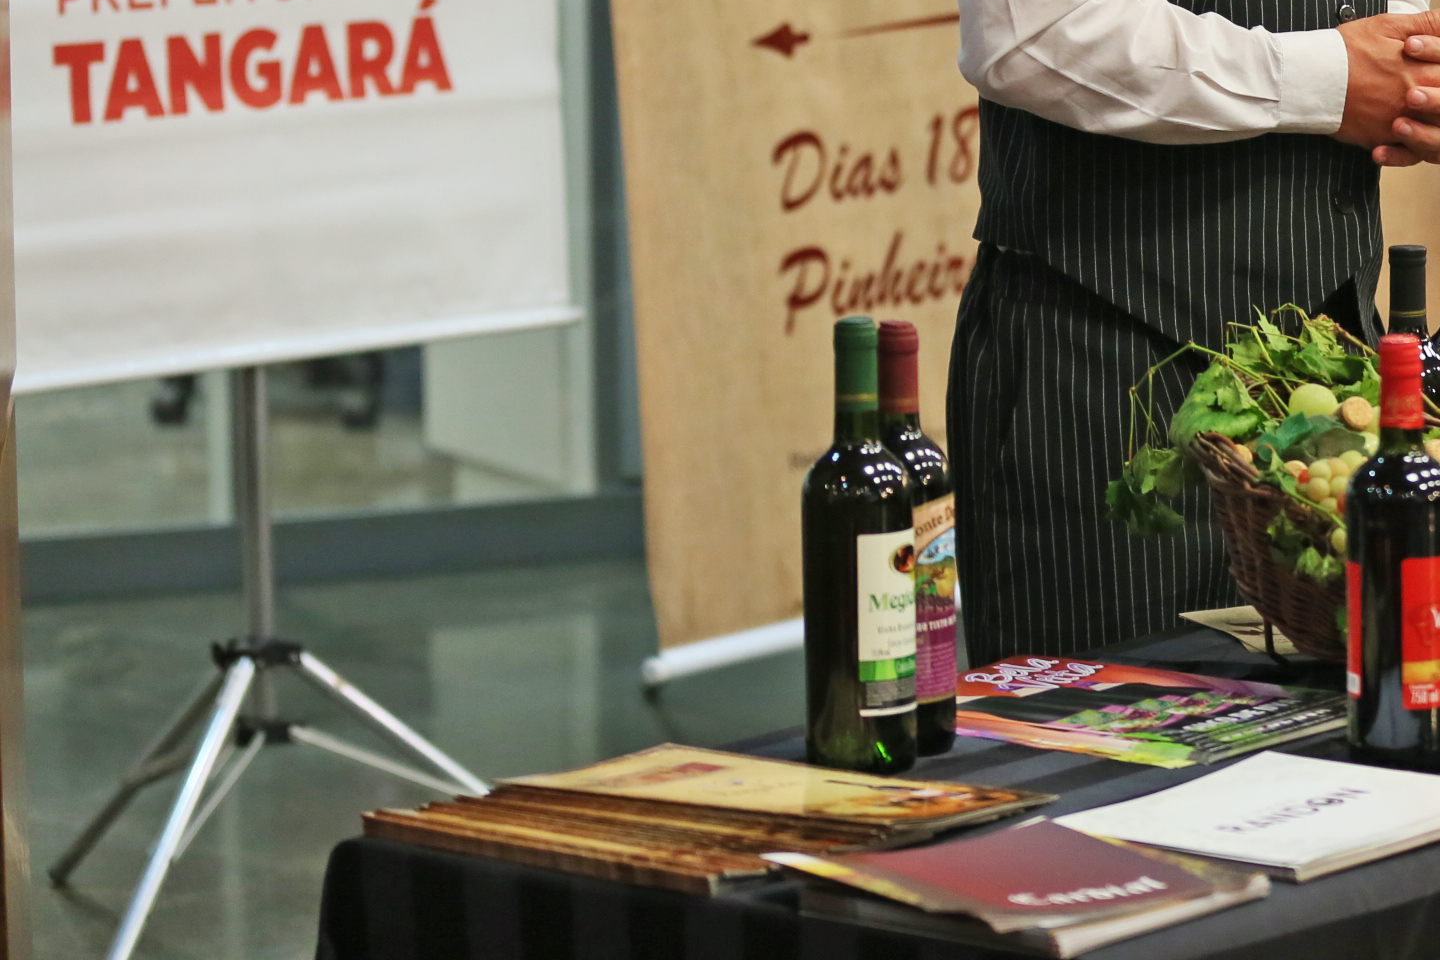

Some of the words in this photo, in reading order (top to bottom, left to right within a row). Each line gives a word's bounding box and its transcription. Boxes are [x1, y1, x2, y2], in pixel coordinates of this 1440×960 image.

[773, 129, 904, 213] Dias
[779, 231, 977, 336] Pinheir
[915, 515, 943, 537] onte
